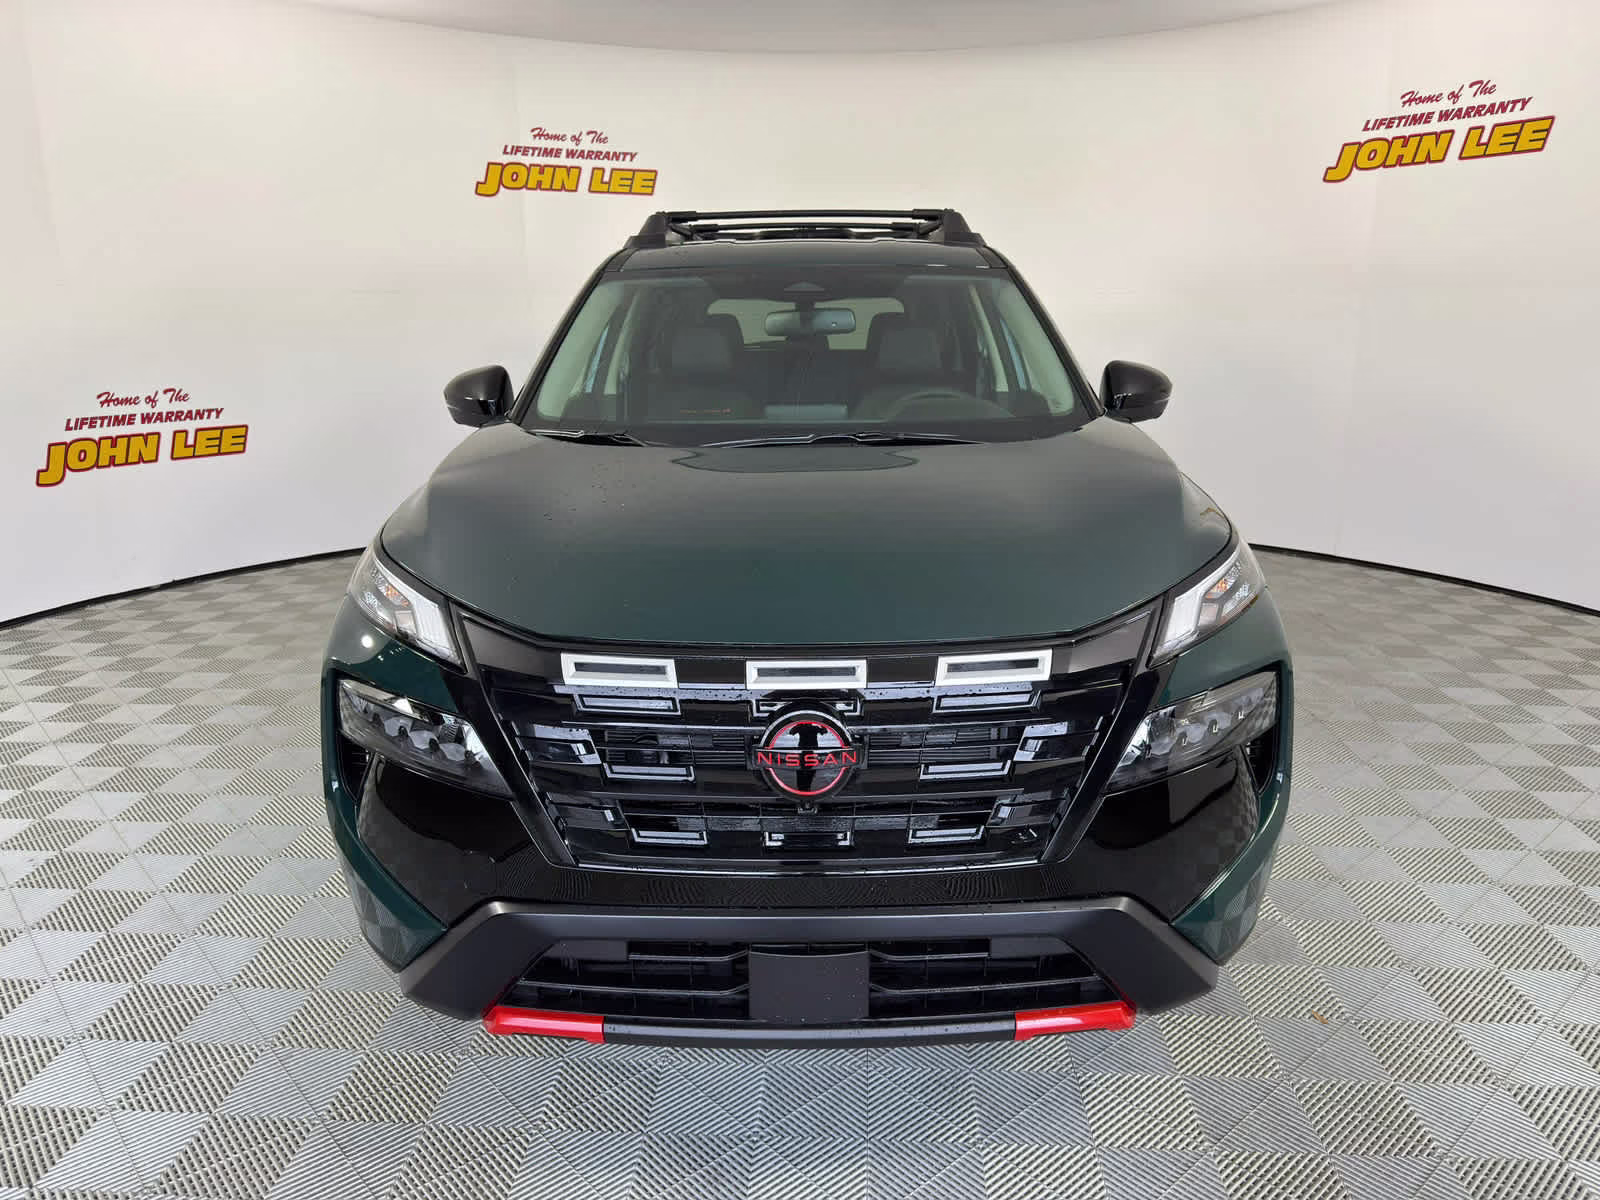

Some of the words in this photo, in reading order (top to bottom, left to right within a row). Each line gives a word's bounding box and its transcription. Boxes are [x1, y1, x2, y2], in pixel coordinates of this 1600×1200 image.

[1400, 90, 1443, 108] Home
[1447, 84, 1464, 104] of
[1468, 79, 1497, 98] The
[1362, 111, 1435, 132] LIFETIME
[1437, 96, 1533, 122] WARRANTY
[530, 126, 567, 142] Home
[570, 131, 583, 146] of
[586, 130, 609, 144] The
[1322, 129, 1456, 183] JOHN
[1458, 115, 1556, 160] LEE
[502, 144, 563, 159] LIFETIME
[565, 148, 638, 162] WARRANTY
[475, 162, 582, 197] JOHN
[588, 167, 658, 196] LEE
[96, 391, 140, 408] Home
[145, 390, 159, 409] of
[163, 388, 190, 404] The
[64, 413, 137, 432] LIFETIME
[139, 407, 224, 425] WARRANTY
[36, 432, 161, 487] JOHN
[170, 424, 249, 461] LEE
[757, 751, 857, 766] NISSAN
